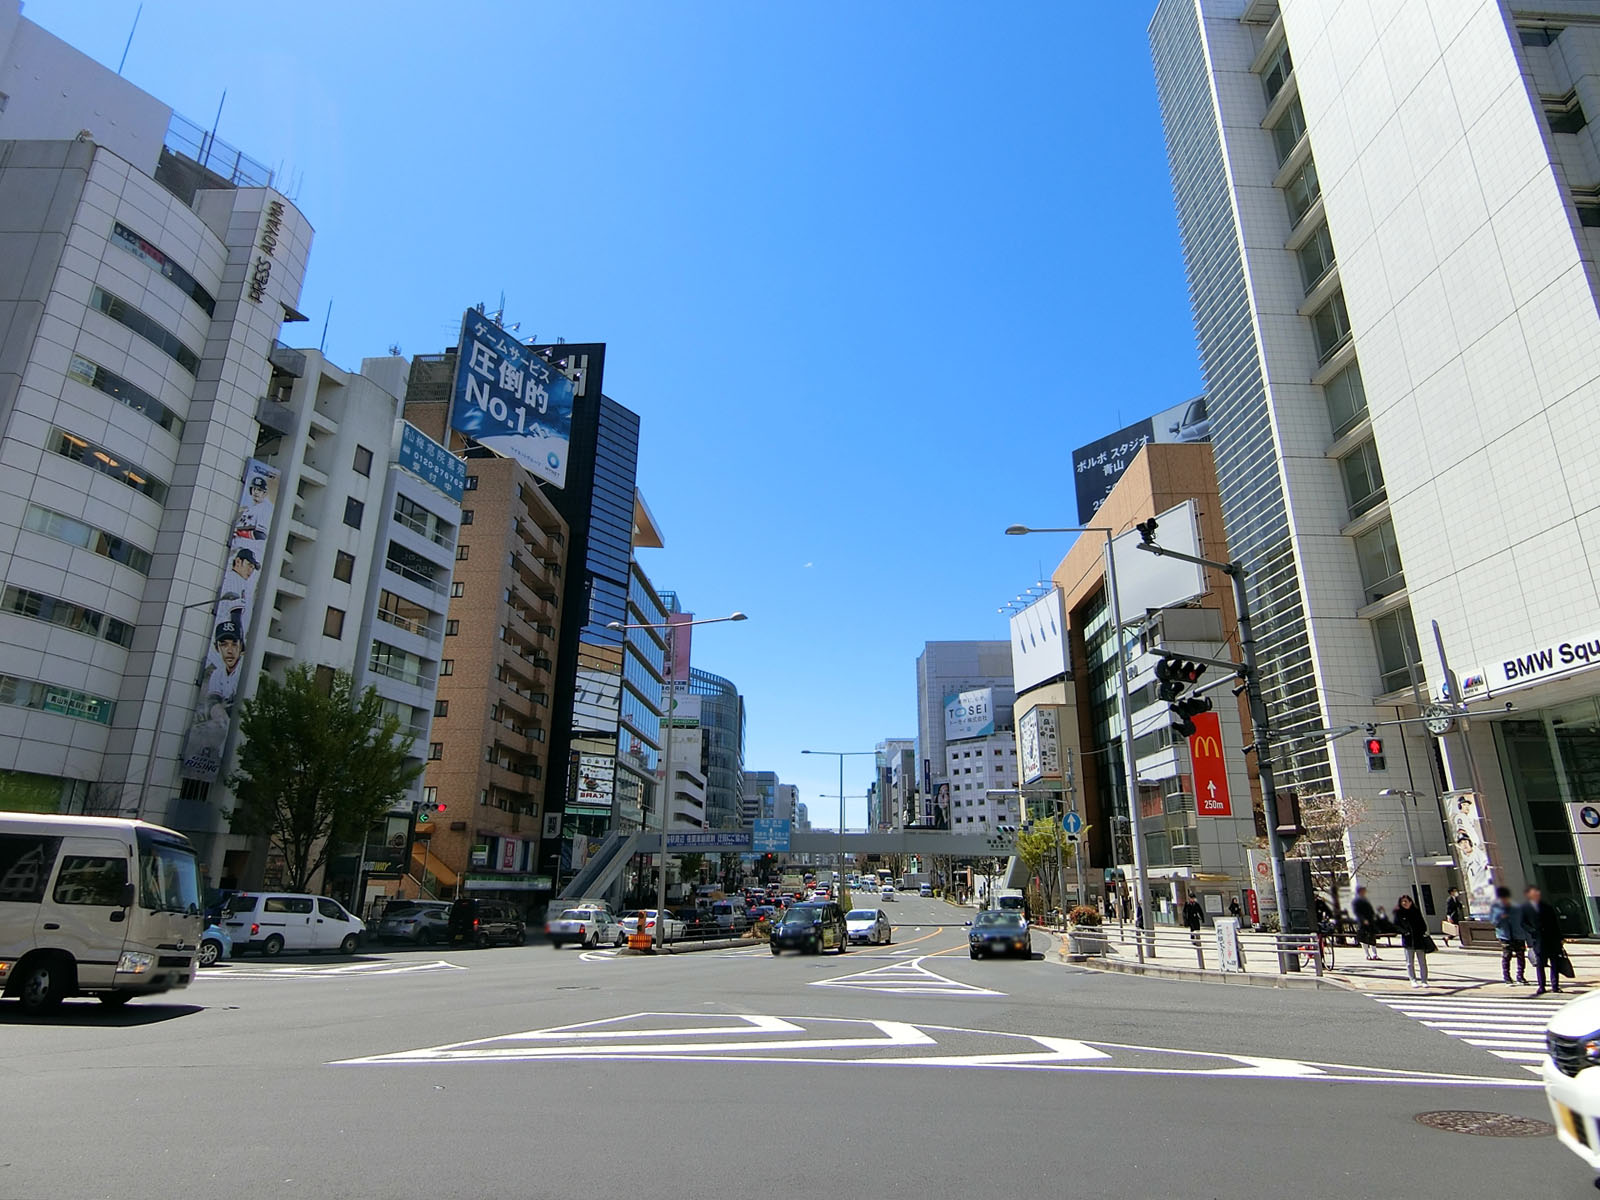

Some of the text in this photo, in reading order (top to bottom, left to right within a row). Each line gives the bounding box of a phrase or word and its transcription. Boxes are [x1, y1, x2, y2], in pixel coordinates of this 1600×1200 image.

[249, 200, 286, 304] PRESS AOYAMA
[474, 322, 550, 384] ゲームサービス
[468, 340, 549, 415] 圧倒的
[1077, 434, 1149, 472] ボルボ スタジオ
[1103, 459, 1124, 476] 青山
[1503, 639, 1600, 681] BMW Squ
[949, 703, 987, 719] TOSEI
[1204, 800, 1224, 809] 250m
[362, 861, 391, 871] SUBWAY
